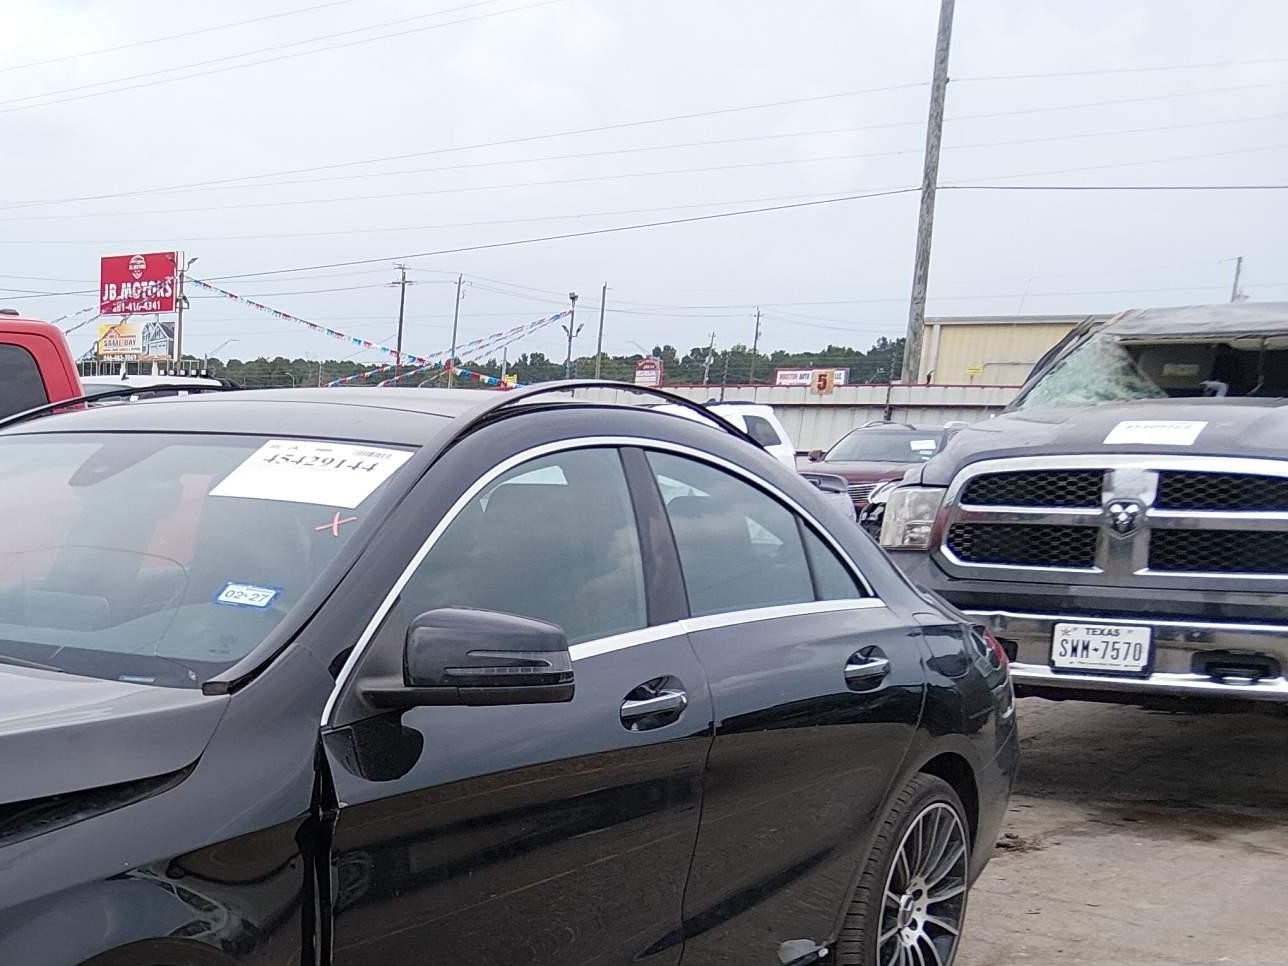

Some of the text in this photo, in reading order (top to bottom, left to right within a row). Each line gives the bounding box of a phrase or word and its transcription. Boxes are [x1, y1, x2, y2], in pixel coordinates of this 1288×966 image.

[103, 280, 173, 301] JB MOTORS
[817, 373, 828, 391] 5
[264, 453, 379, 472] 45429144
[1084, 627, 1121, 637] TEXAS
